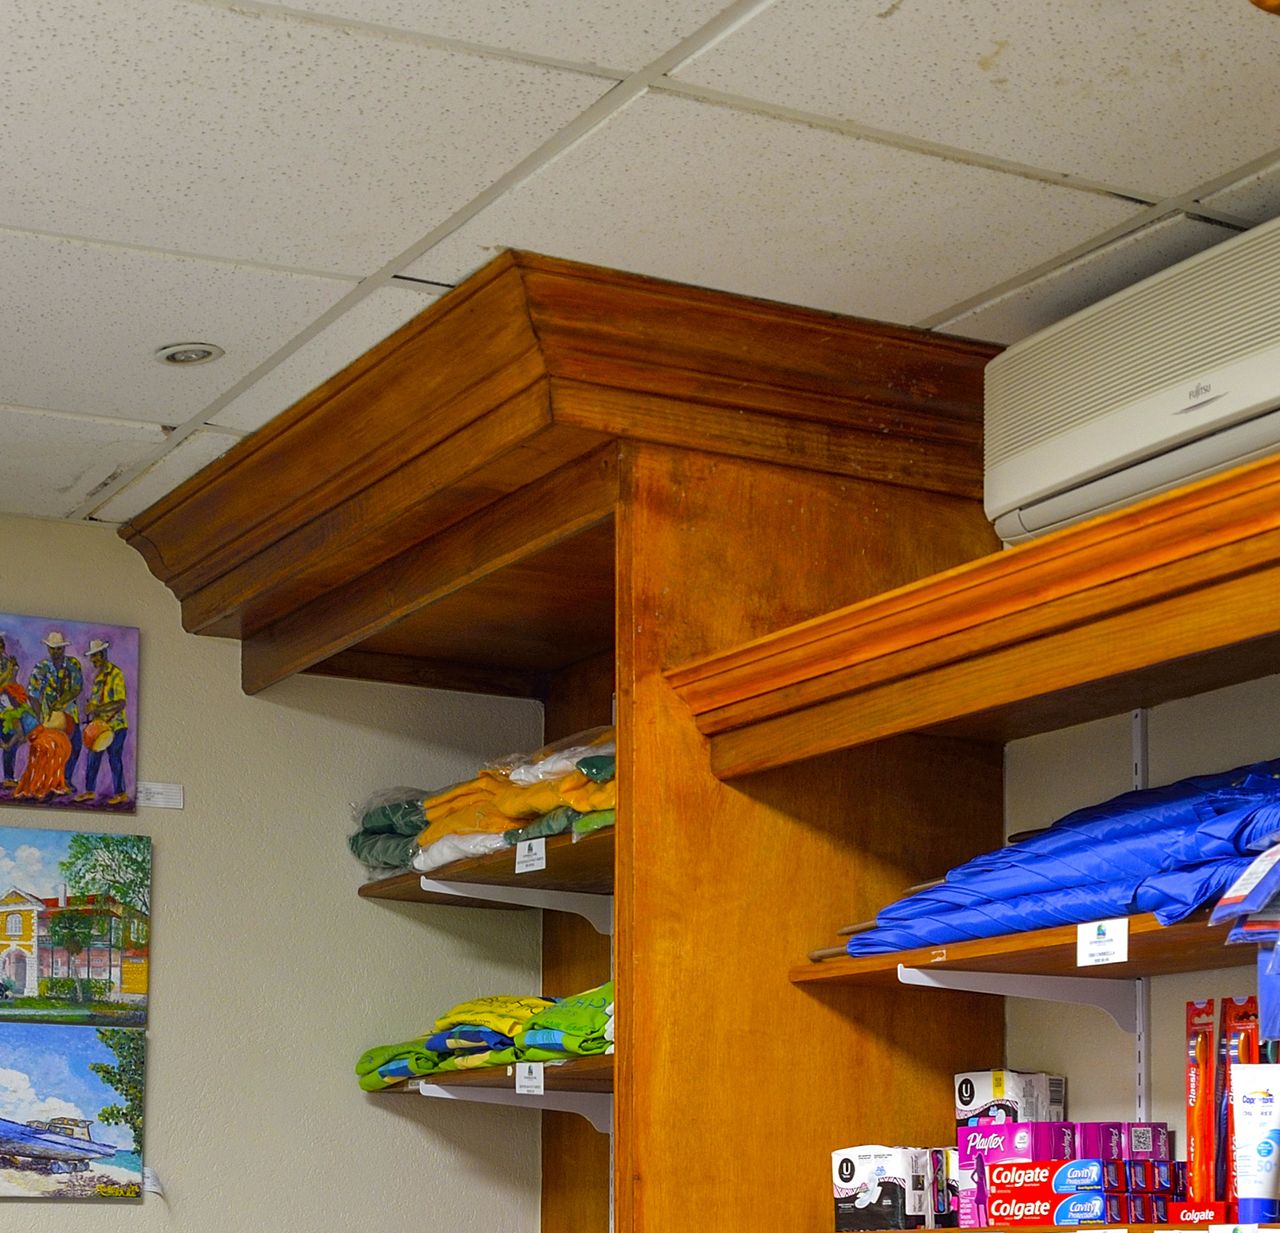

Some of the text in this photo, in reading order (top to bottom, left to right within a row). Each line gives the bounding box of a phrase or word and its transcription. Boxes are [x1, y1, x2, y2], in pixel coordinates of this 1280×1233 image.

[1188, 382, 1211, 400] FUJITSU
[962, 1082, 970, 1097] U
[1242, 1094, 1274, 1104] Coptone
[967, 1132, 1005, 1155] Playtex
[843, 1162, 851, 1175] U
[992, 1167, 1049, 1188] Colgate
[990, 1199, 1051, 1220] Colgate
[1180, 1209, 1215, 1223] Colgate
